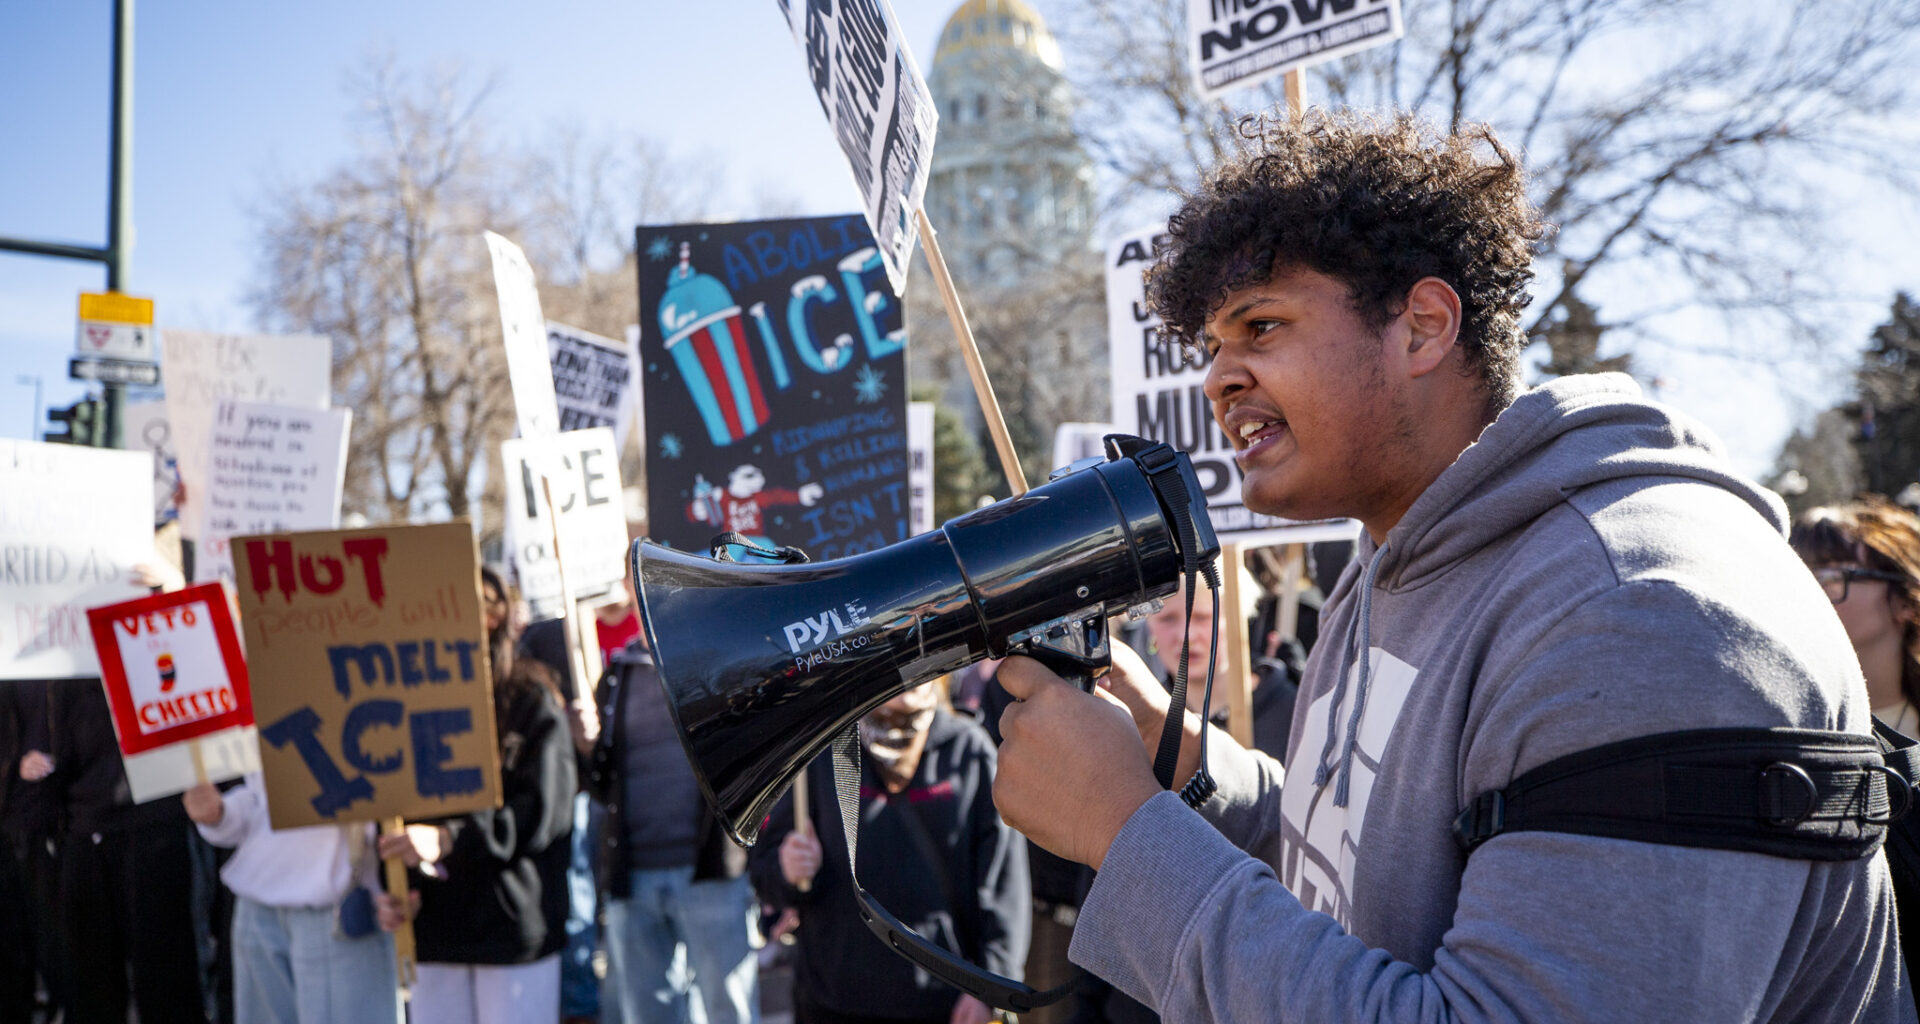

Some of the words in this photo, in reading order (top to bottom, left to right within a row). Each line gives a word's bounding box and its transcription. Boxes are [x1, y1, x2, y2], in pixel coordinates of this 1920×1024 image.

[1200, 0, 1388, 61] NOW
[749, 247, 907, 390] ICE
[801, 481, 904, 547] ISN'T
[245, 537, 388, 610] HOT
[120, 604, 197, 638] VETO
[254, 598, 380, 647] people
[402, 584, 461, 626] will
[783, 598, 871, 654] PYLE
[326, 639, 478, 700] MELT
[139, 687, 232, 727] CHEETO
[261, 698, 485, 819] ICE
